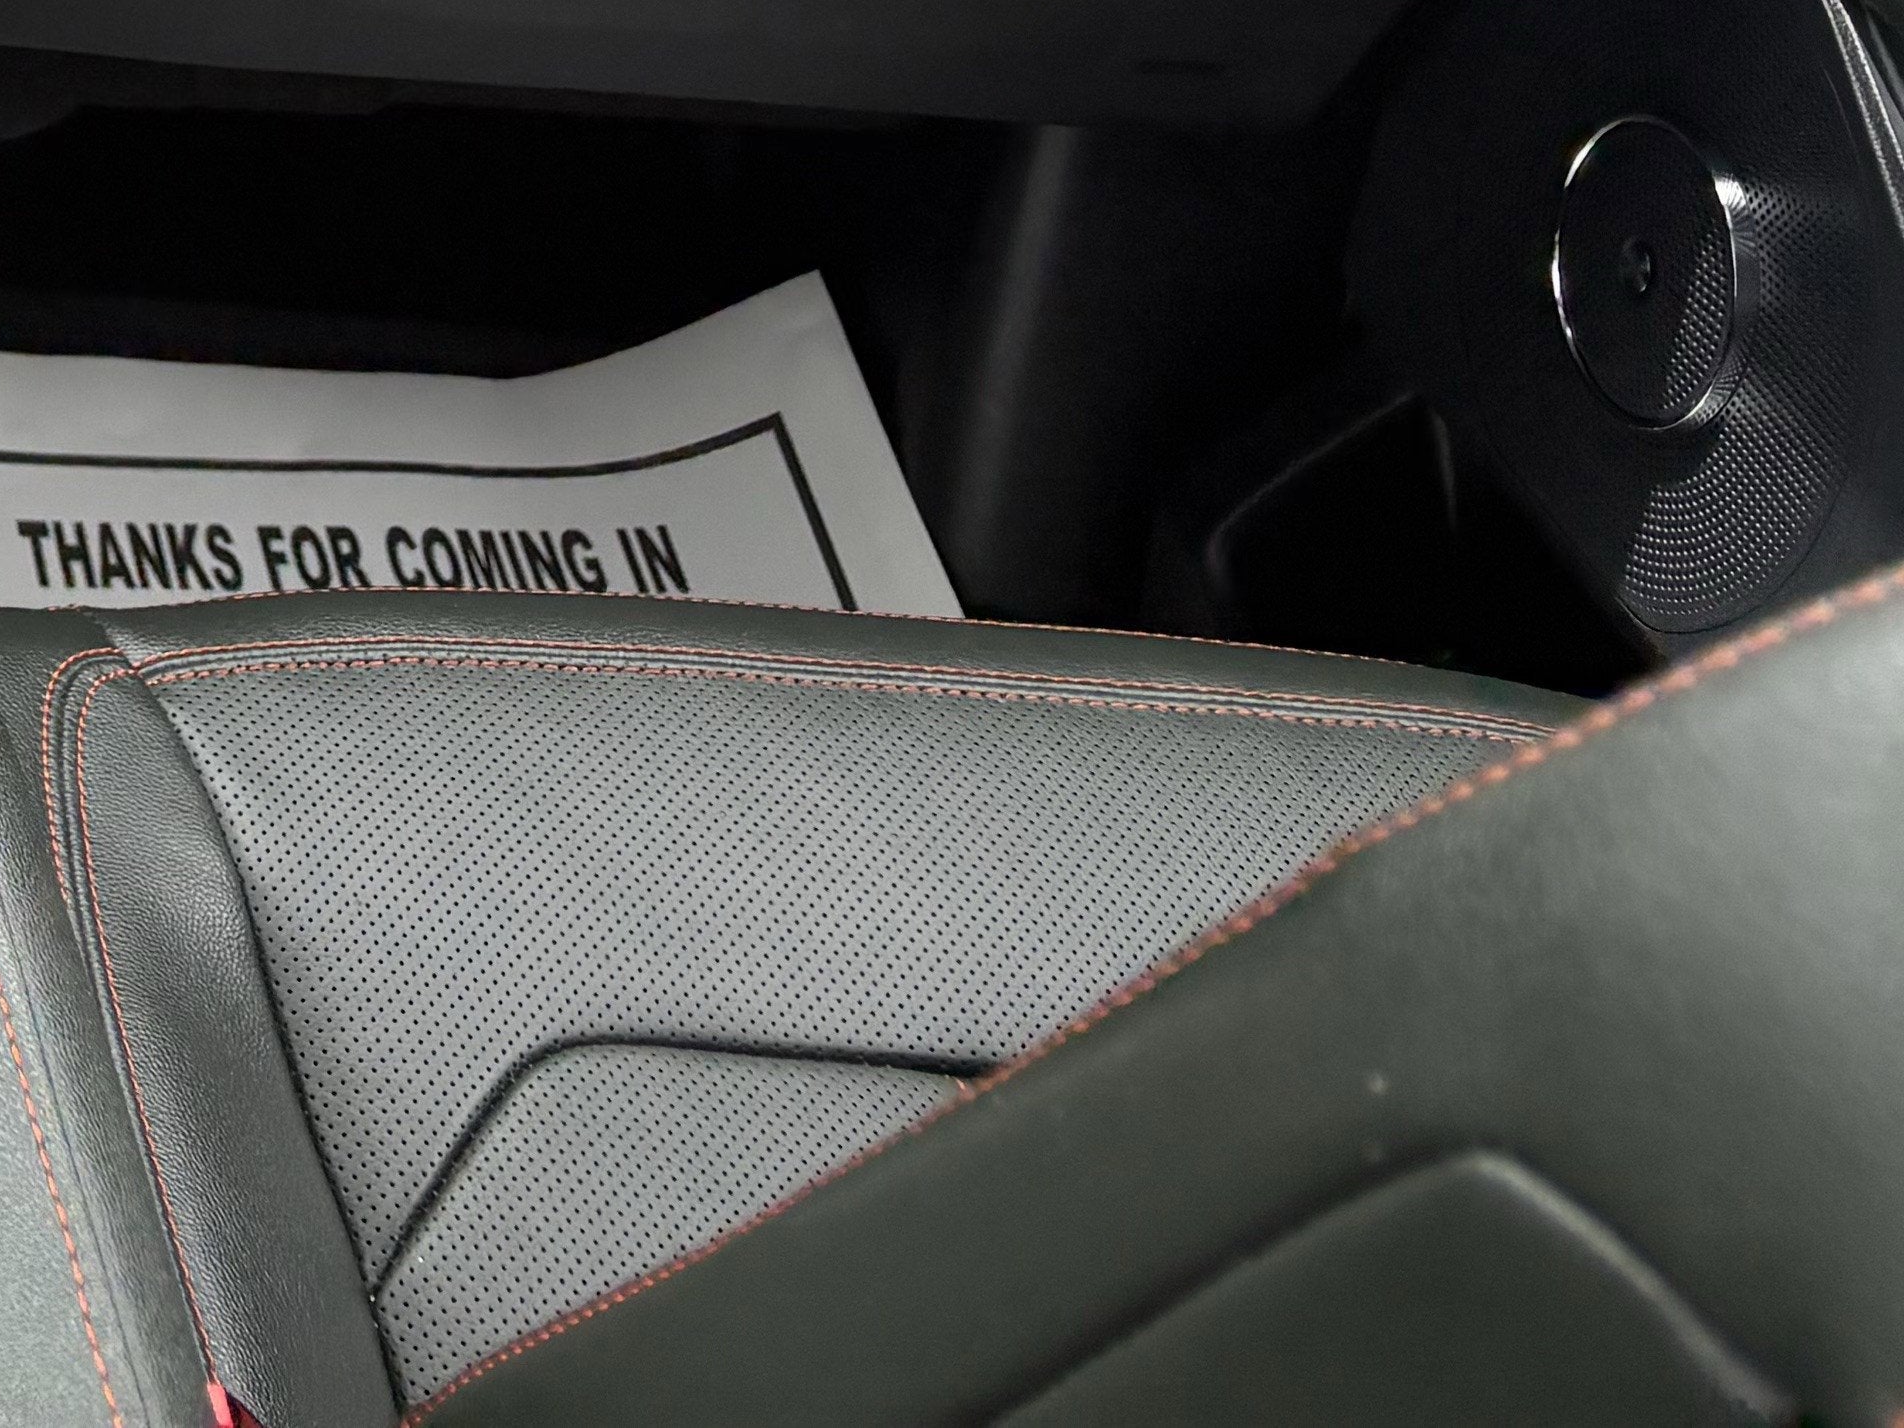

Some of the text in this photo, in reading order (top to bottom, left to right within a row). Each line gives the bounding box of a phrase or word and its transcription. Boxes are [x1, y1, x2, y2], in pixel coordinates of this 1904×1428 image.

[16, 517, 691, 595] THANKS FOR COMING IN
